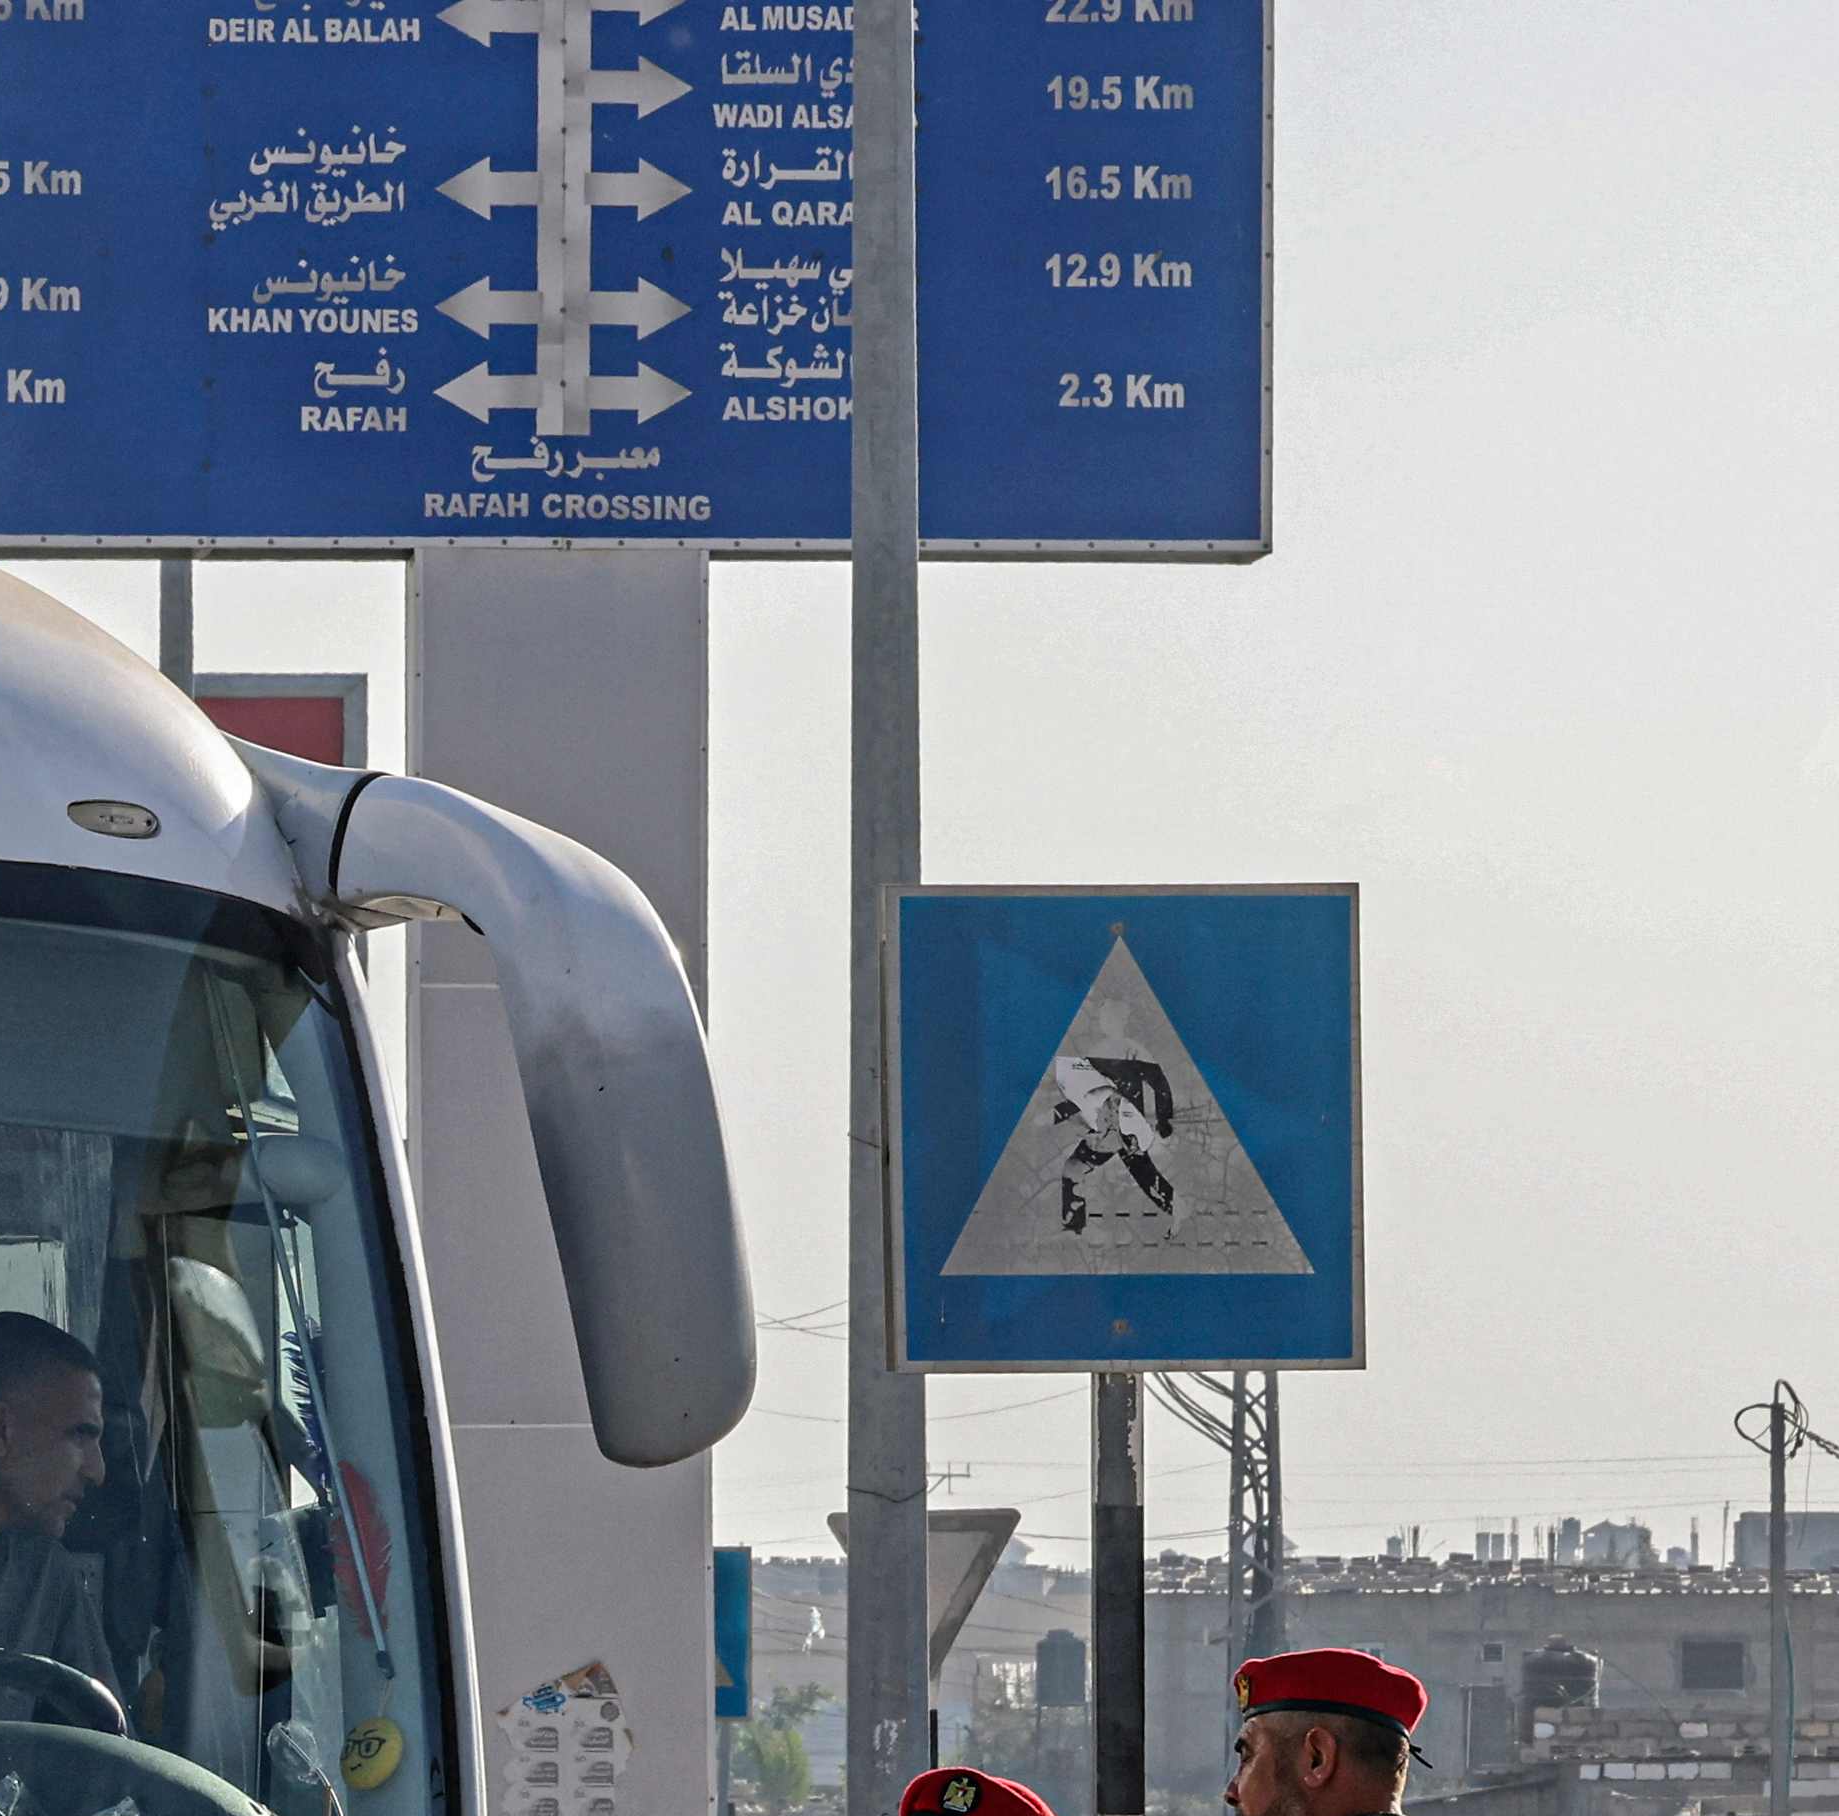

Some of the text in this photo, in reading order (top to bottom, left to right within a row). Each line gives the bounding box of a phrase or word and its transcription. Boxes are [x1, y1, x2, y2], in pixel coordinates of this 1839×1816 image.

[25, 0, 85, 21] Km
[720, 6, 757, 31] AL
[1045, 0, 1194, 22] 22.9 Km
[209, 18, 421, 43] DEIR AL BALAH
[721, 50, 812, 85] السلقا
[1046, 76, 1194, 110] 19.5 Km
[713, 104, 783, 129] WADI
[249, 126, 406, 177] خانيونس
[23, 161, 82, 196] Km
[1045, 166, 1193, 200] 16.5 Km
[209, 179, 405, 231] الطريق الغربي
[722, 202, 761, 227] AL
[252, 254, 406, 304] خانيونس
[719, 247, 821, 291] سهيلا
[1045, 252, 1193, 288] 12.9 Km
[22, 278, 81, 312] Km
[208, 308, 418, 334] KHAN YOUNES
[719, 291, 808, 336] خزاعة
[7, 369, 67, 404] Km
[313, 346, 406, 397] رفح
[1058, 373, 1186, 408] 2.3 Km
[301, 406, 408, 432] RAFAH
[471, 436, 661, 483] معبر رفح
[424, 493, 712, 521] RAFAH CROSSING
